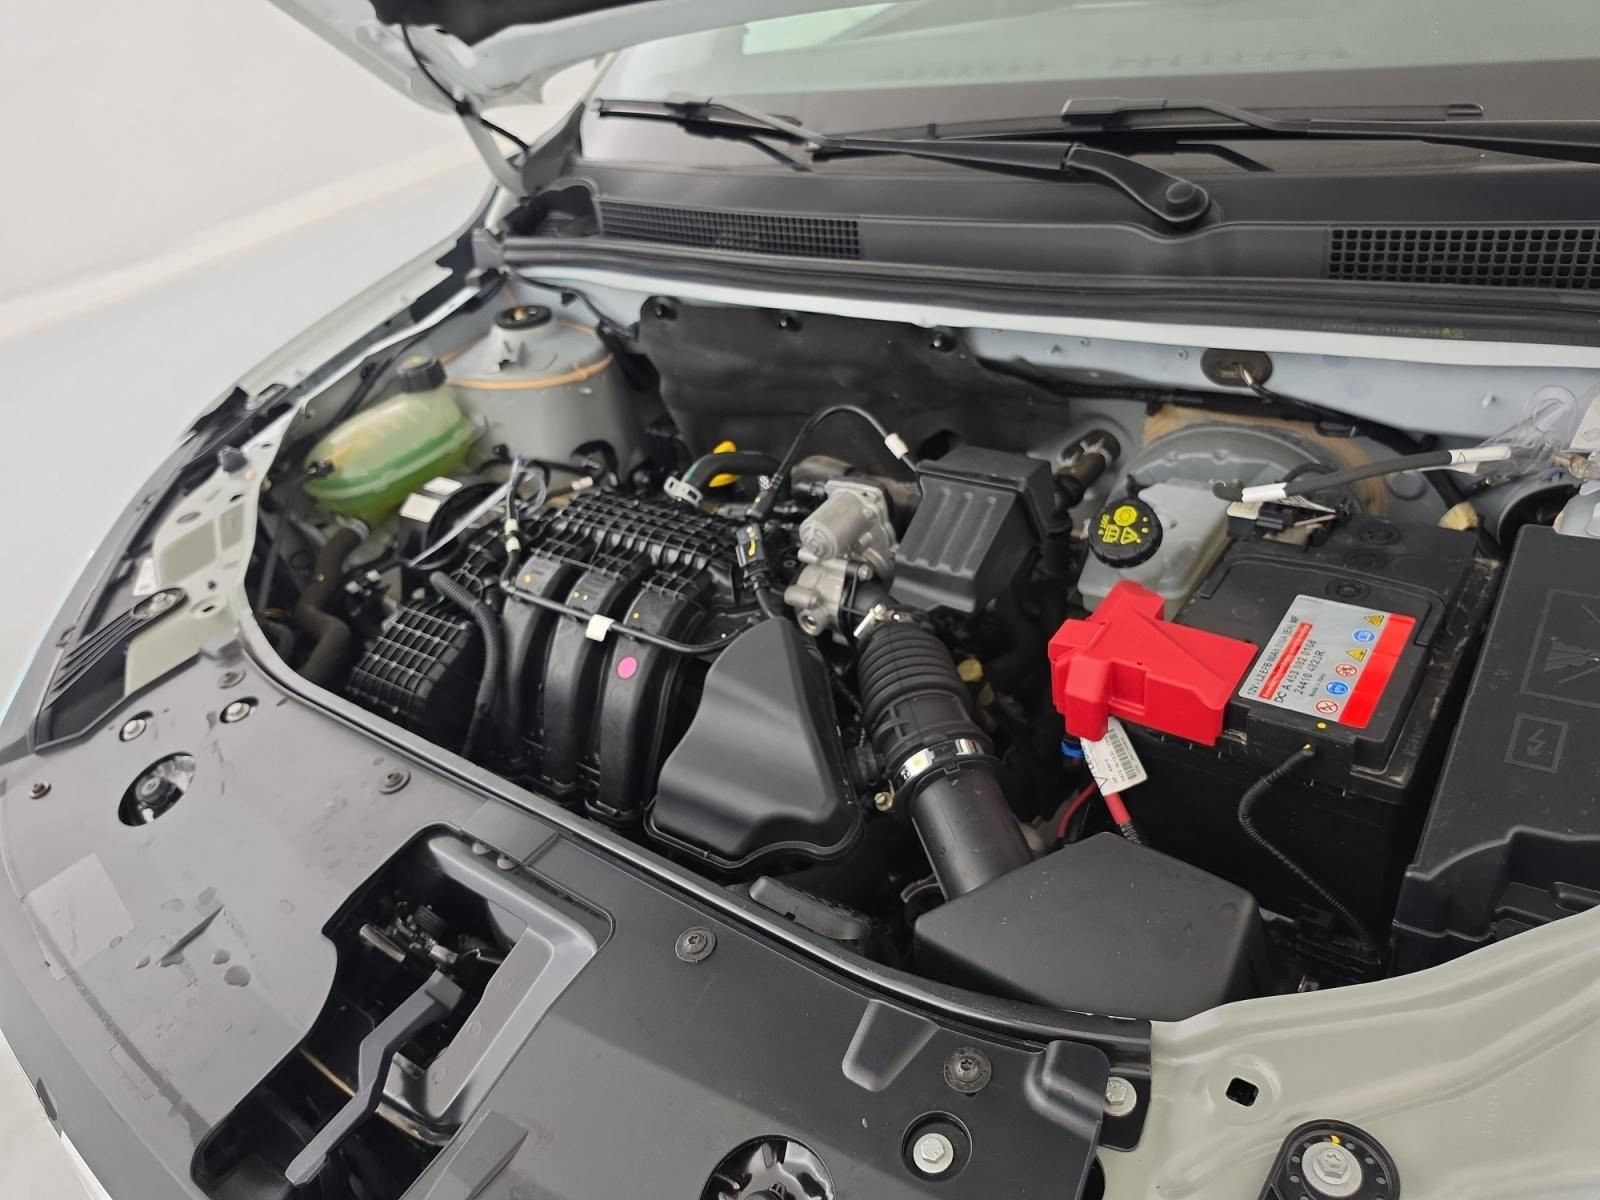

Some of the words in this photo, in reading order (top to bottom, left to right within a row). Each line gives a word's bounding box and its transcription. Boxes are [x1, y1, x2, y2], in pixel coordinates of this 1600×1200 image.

[1247, 685, 1258, 695] 12V
[1274, 691, 1287, 703] DC
[1281, 683, 1291, 691] A
[1286, 669, 1299, 682] 453
[1294, 672, 1312, 694] 24410
